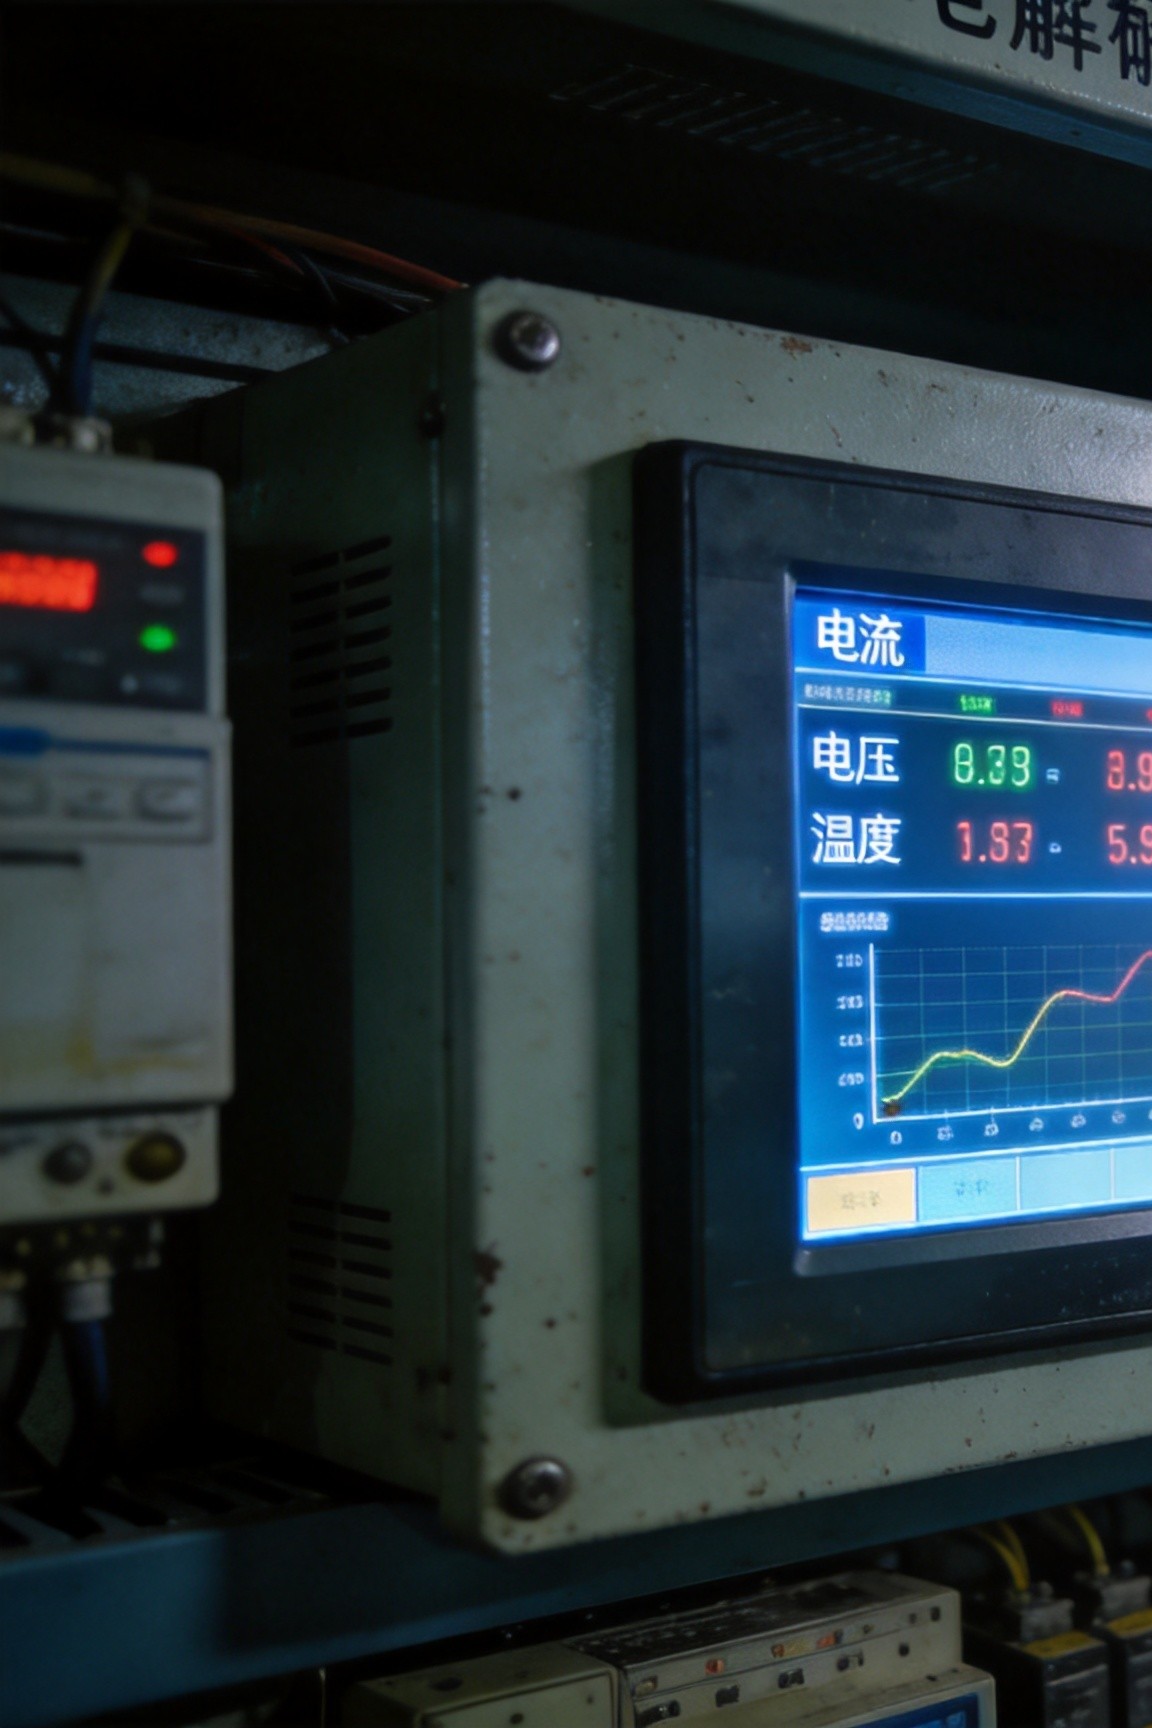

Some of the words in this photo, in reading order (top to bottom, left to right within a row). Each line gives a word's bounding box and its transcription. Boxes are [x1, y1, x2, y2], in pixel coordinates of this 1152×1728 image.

[817, 608, 905, 668] 电流
[812, 730, 900, 786] 电压
[810, 811, 902, 865] 温度
